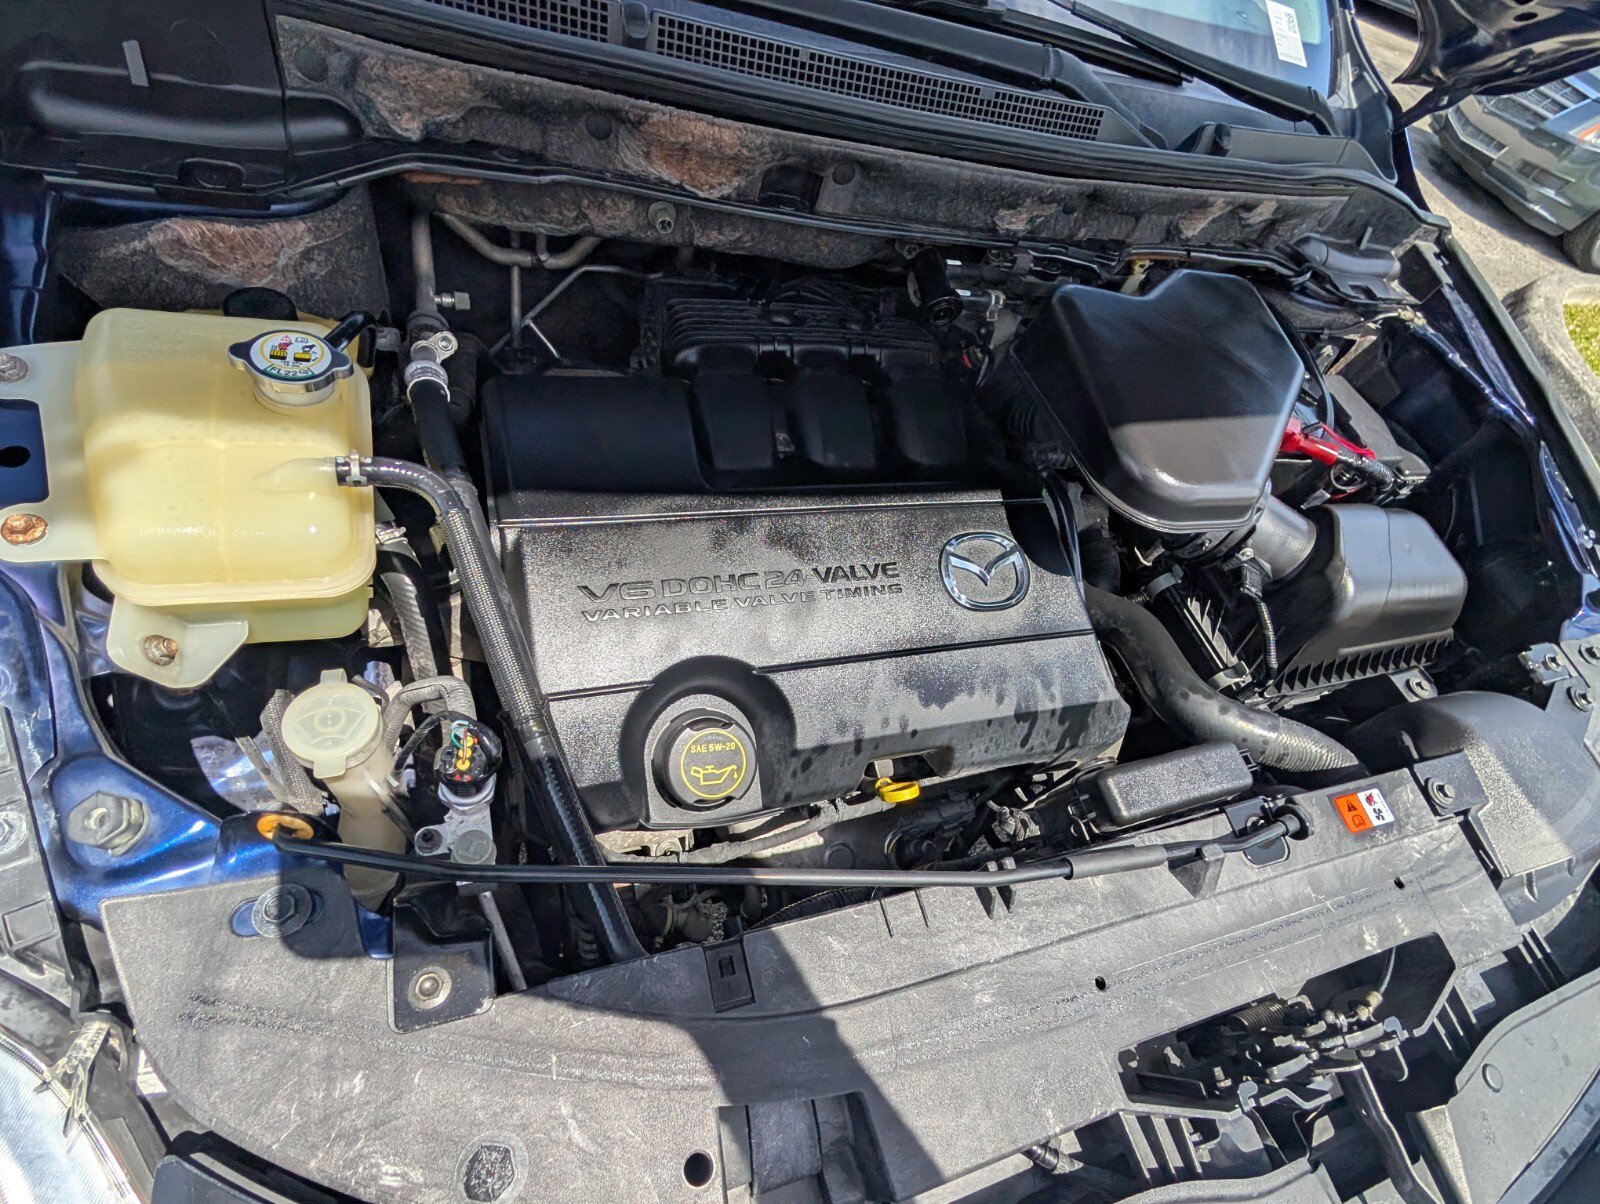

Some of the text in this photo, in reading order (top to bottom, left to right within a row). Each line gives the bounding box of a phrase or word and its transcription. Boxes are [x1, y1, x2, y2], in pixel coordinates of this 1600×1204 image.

[577, 581, 656, 603] V6
[661, 573, 760, 597] DOHC
[582, 583, 904, 622] VARIABLE VALVE TIMING
[690, 742, 736, 753] SAE 5W-20
